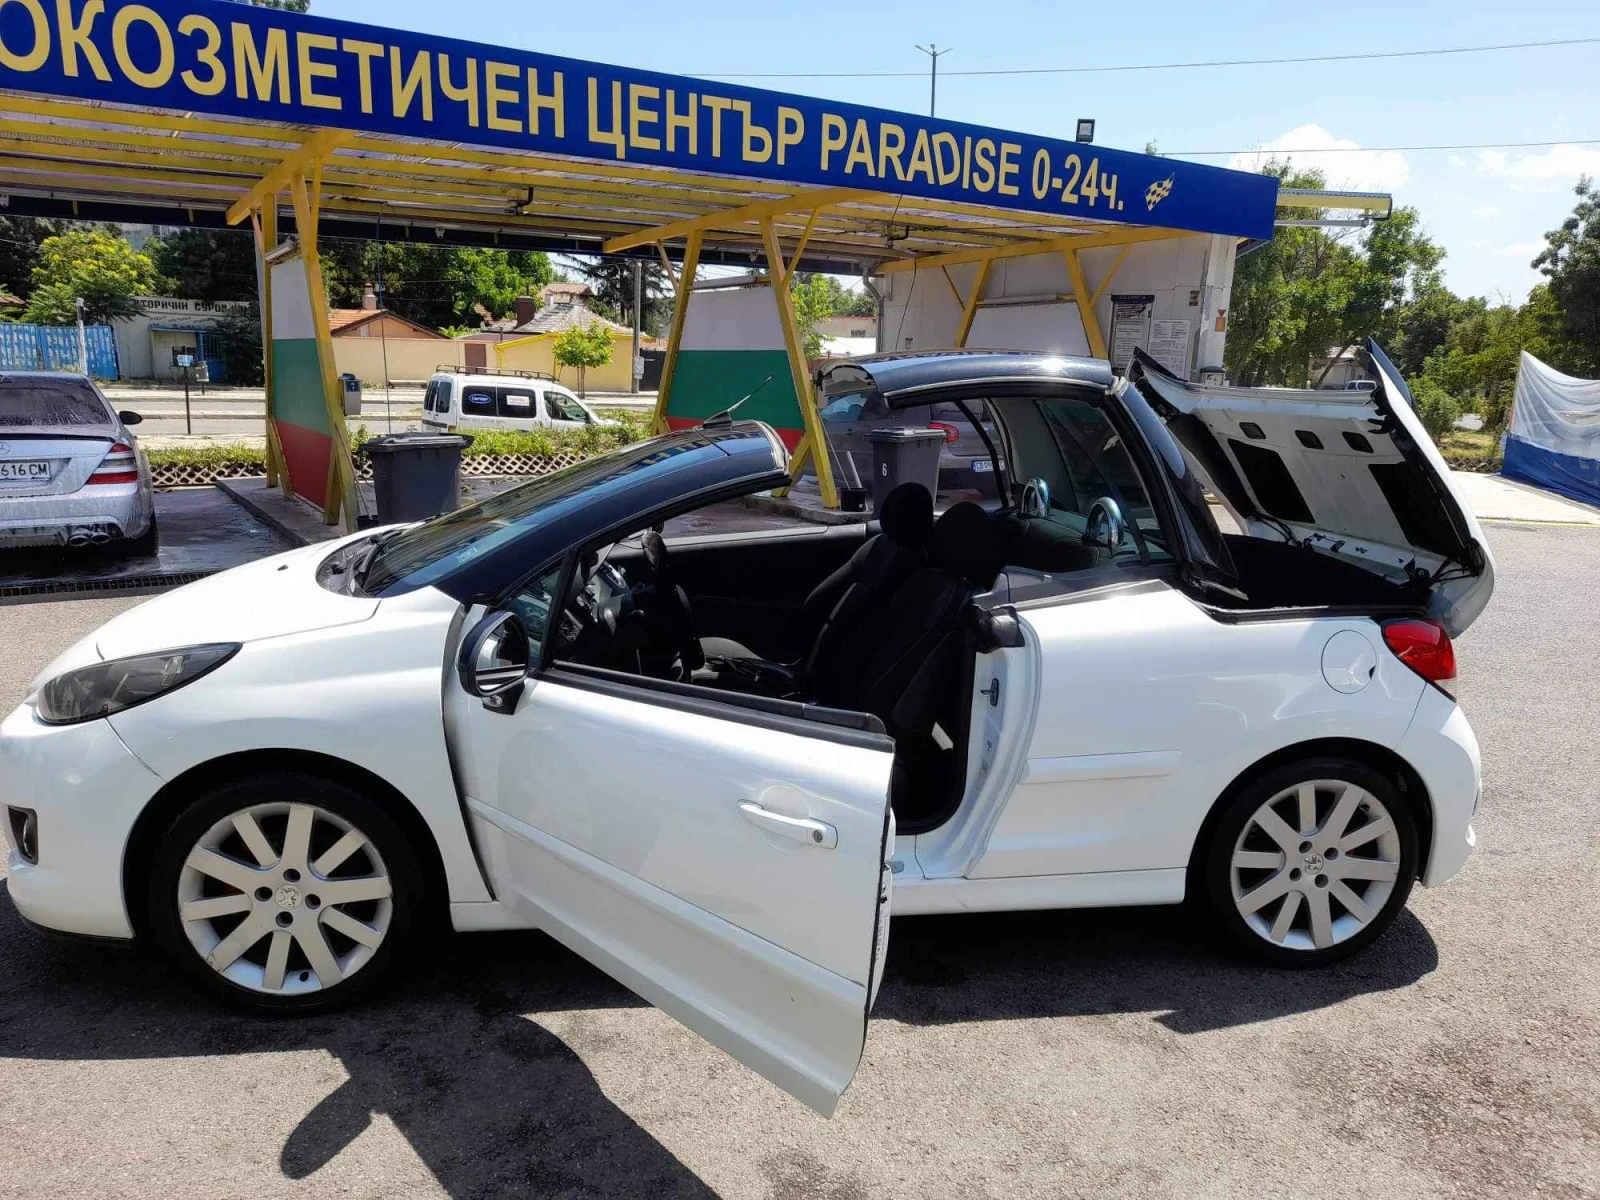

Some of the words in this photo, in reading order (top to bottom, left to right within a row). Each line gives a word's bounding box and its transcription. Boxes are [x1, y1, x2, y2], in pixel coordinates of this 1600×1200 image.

[0, 0, 565, 138] ОКОЗМЕТИЧЕН
[587, 76, 805, 162] ЦЕНТЪР
[820, 112, 1022, 196] PARADISE
[1031, 149, 1124, 211] 0-24ч.
[882, 462, 888, 477] 6
